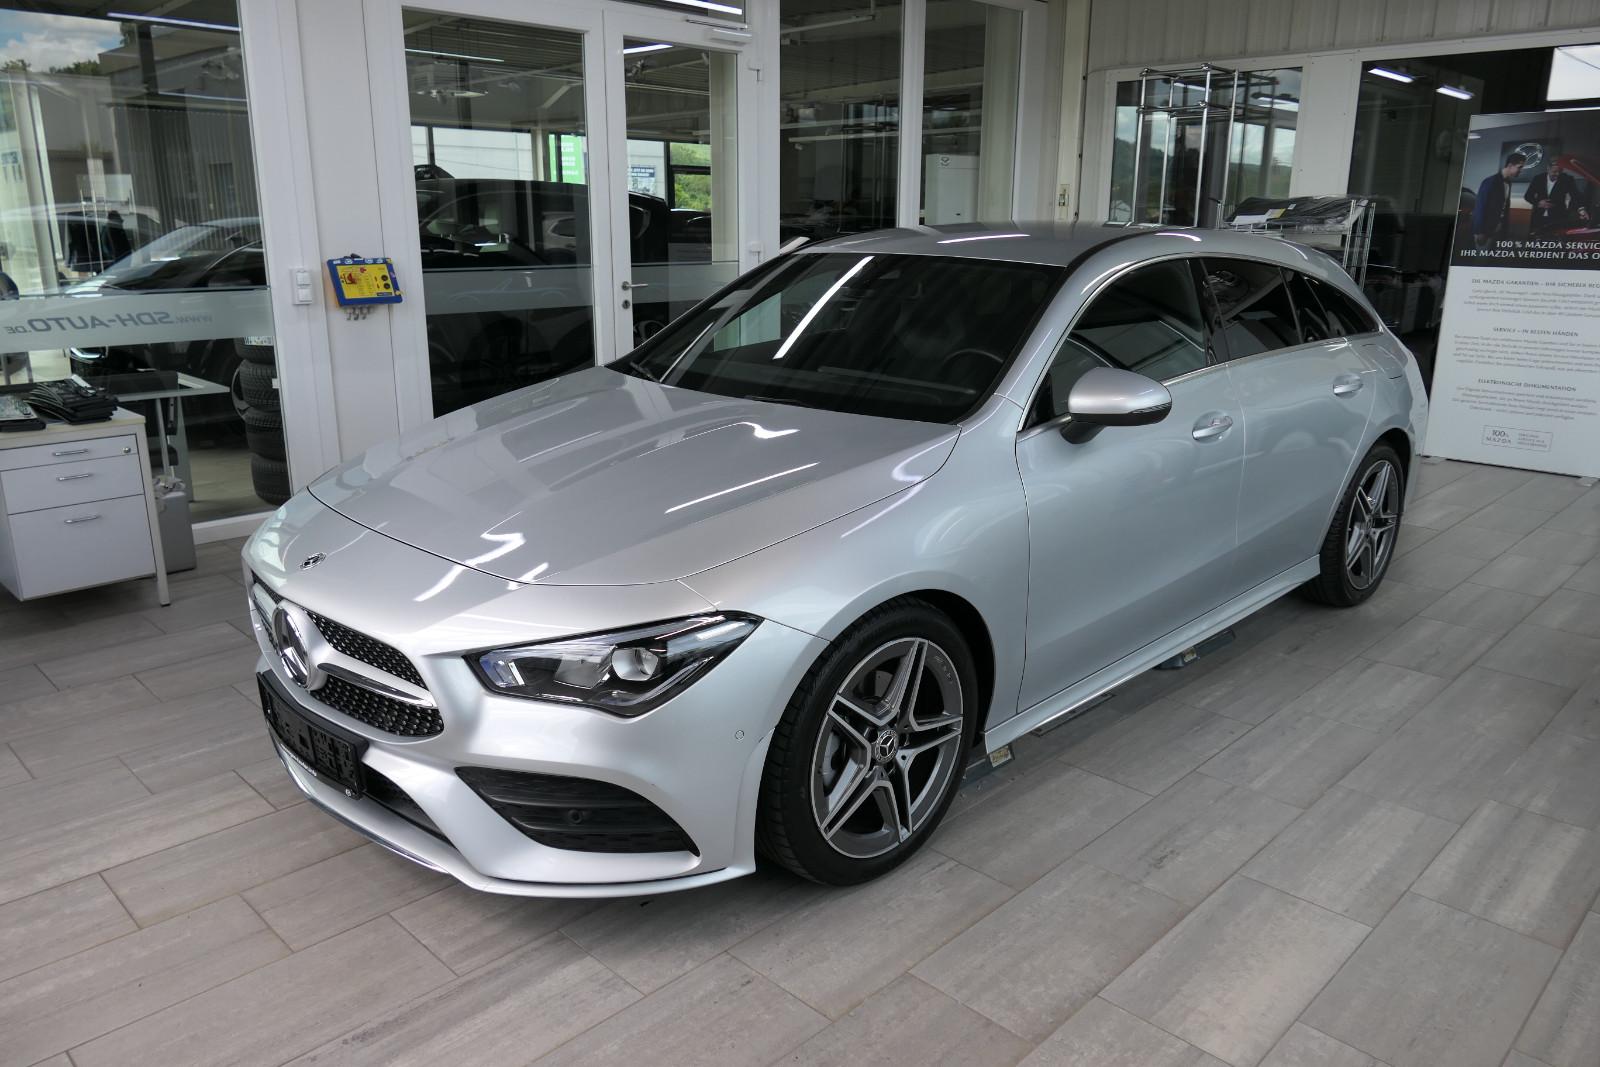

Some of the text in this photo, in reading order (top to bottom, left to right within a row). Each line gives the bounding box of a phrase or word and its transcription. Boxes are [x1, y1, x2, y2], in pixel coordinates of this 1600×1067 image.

[1495, 240, 1513, 248] 100
[1525, 241, 1562, 249] MAZDA
[1460, 249, 1477, 257] IHR
[1479, 250, 1515, 258] MAZDA
[1518, 251, 1567, 259] VERDIENT
[1568, 251, 1589, 260] DAS
